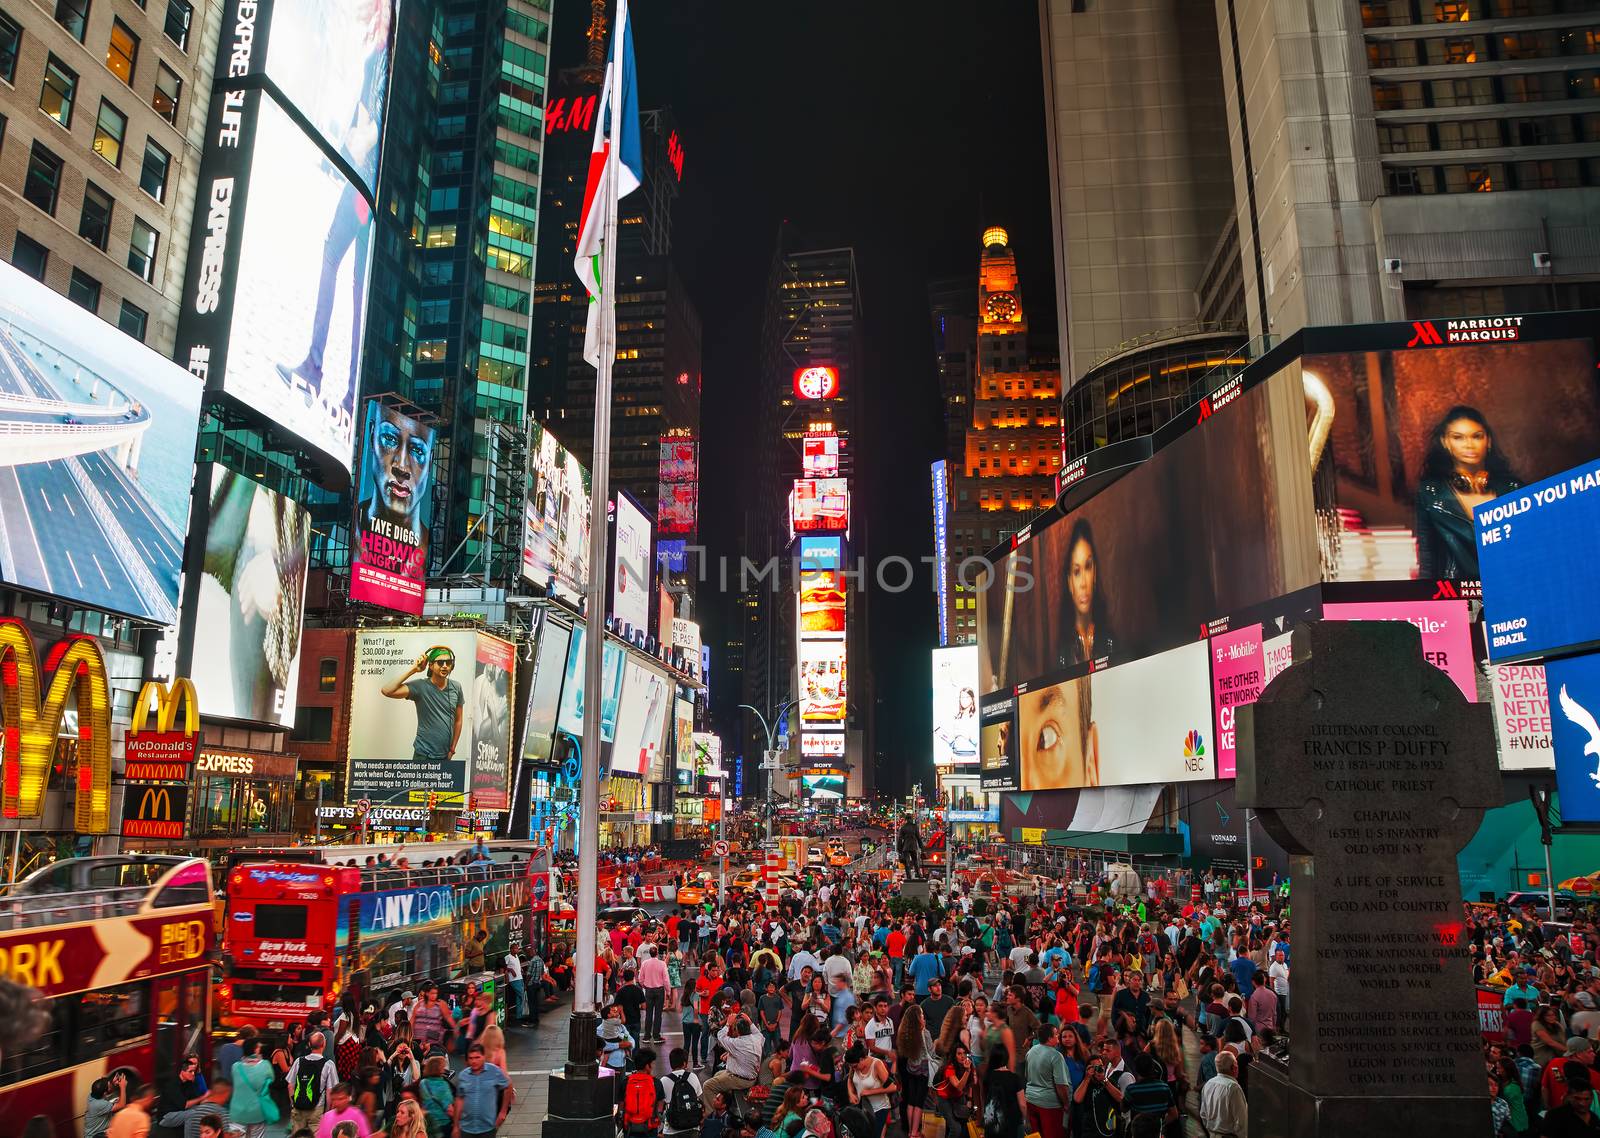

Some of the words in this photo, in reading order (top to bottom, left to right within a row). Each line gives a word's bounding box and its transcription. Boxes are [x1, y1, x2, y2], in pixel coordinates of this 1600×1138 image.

[196, 177, 234, 314] EXPRESS
[1448, 317, 1522, 330] MARRIOTT
[1450, 329, 1515, 341] MARQUIS
[1212, 374, 1244, 400] MARRIOTT
[1213, 386, 1241, 411] MARQUIS
[1061, 457, 1087, 477] MARRIOTT
[1061, 468, 1084, 487] MARQUIS
[1479, 498, 1531, 526] WOULD
[1534, 485, 1567, 506] YOU
[795, 519, 847, 529] TOSHIBA
[371, 517, 392, 537] TAYE
[394, 525, 419, 546] DIGGS
[939, 526, 945, 536] at
[1482, 530, 1501, 545] ME
[1503, 524, 1511, 538] ?
[362, 530, 424, 566] HEDWIG
[813, 548, 838, 557] TDK
[361, 551, 397, 570] ANGRY
[1209, 616, 1229, 628] MARRIOTT
[1492, 618, 1527, 634] THIAGO
[1209, 625, 1228, 634] MARQUIS
[385, 638, 395, 646] get
[1493, 632, 1527, 647] BRAZIL
[383, 658, 414, 666] experience
[1498, 667, 1545, 682] SPAN
[1219, 676, 1232, 690] THE
[1234, 671, 1259, 688] OTHER
[1220, 687, 1260, 705] NETWORKS
[1311, 725, 1379, 736] LIEUTENANT
[1383, 725, 1437, 736] COLONEL
[128, 740, 193, 751] McDonald's
[803, 737, 820, 747] MAN
[1304, 741, 1372, 756] FRANCIS
[1377, 741, 1386, 755] P
[1395, 741, 1451, 756] DUFFY
[197, 753, 254, 774] EXPRESS
[368, 762, 384, 770] needs
[393, 762, 420, 770] education
[1185, 758, 1205, 772] NBC
[1313, 761, 1335, 770] MAY
[1338, 761, 1344, 770] 2
[1406, 761, 1418, 770] 26
[1420, 761, 1443, 770] 1932
[397, 771, 415, 779] Cuomo
[417, 771, 421, 779] is
[422, 772, 441, 780] raising
[410, 780, 429, 788] dollars
[1325, 780, 1384, 792] CATHOLIC
[1392, 780, 1435, 792] PRIEST
[315, 807, 354, 818] GIFTS
[1353, 811, 1411, 821] CHAPLAIN
[1329, 828, 1360, 839] 165TH
[1365, 829, 1374, 839] U
[1377, 829, 1383, 839] S
[1388, 828, 1439, 839] INFANTRY
[1344, 844, 1368, 854] OLD
[1372, 844, 1399, 854] 69TH
[1403, 844, 1410, 854] N
[1415, 844, 1423, 854] Y
[1334, 877, 1343, 887] A
[1347, 877, 1371, 887] LIFE
[1375, 877, 1390, 887] OF
[1396, 877, 1445, 887] SERVICE
[1379, 890, 1399, 898] FOR
[371, 894, 414, 931] ANY
[418, 887, 466, 923] POINT
[469, 886, 488, 914] OF
[492, 881, 524, 913] VIEW
[1330, 902, 1359, 912] GOD
[1363, 902, 1388, 912] AND
[1393, 902, 1450, 912] COUNTRY
[509, 915, 523, 930] TOP
[160, 922, 188, 945] BIG
[509, 931, 514, 940] OF
[515, 930, 523, 938] THE
[1329, 933, 1371, 944] SPANISH
[1374, 933, 1429, 944] AMERICAN
[1432, 933, 1456, 944] WAR
[259, 941, 282, 950] New
[283, 942, 307, 952] York
[258, 952, 323, 966] Sightseeing
[1317, 950, 1339, 959] NEW
[1344, 950, 1371, 959] YORK
[1376, 950, 1427, 959] NATIONAL
[1432, 950, 1469, 959] GUARD
[1345, 964, 1396, 974] MEXICAN
[1400, 964, 1442, 974] BORDER
[1359, 979, 1400, 990] WORLD
[1406, 979, 1431, 989] WAR
[1318, 1012, 1396, 1022] DISTINGUISHED
[1400, 1012, 1441, 1022] SERVICE
[1444, 1012, 1477, 1022] CROSS
[1319, 1027, 1396, 1038] DISTINGUISHED
[1401, 1027, 1442, 1037] SERVICE
[1447, 1027, 1479, 1037] MEDAL
[1319, 1043, 1395, 1053] CONSPICUOUS
[1401, 1043, 1441, 1052] SERVICE
[1446, 1043, 1480, 1052] CROSS
[1348, 1057, 1386, 1068] LEGION
[1349, 1073, 1386, 1084] CROIX
[1391, 1073, 1405, 1083] DE
[1412, 1073, 1456, 1084] GUERRE
